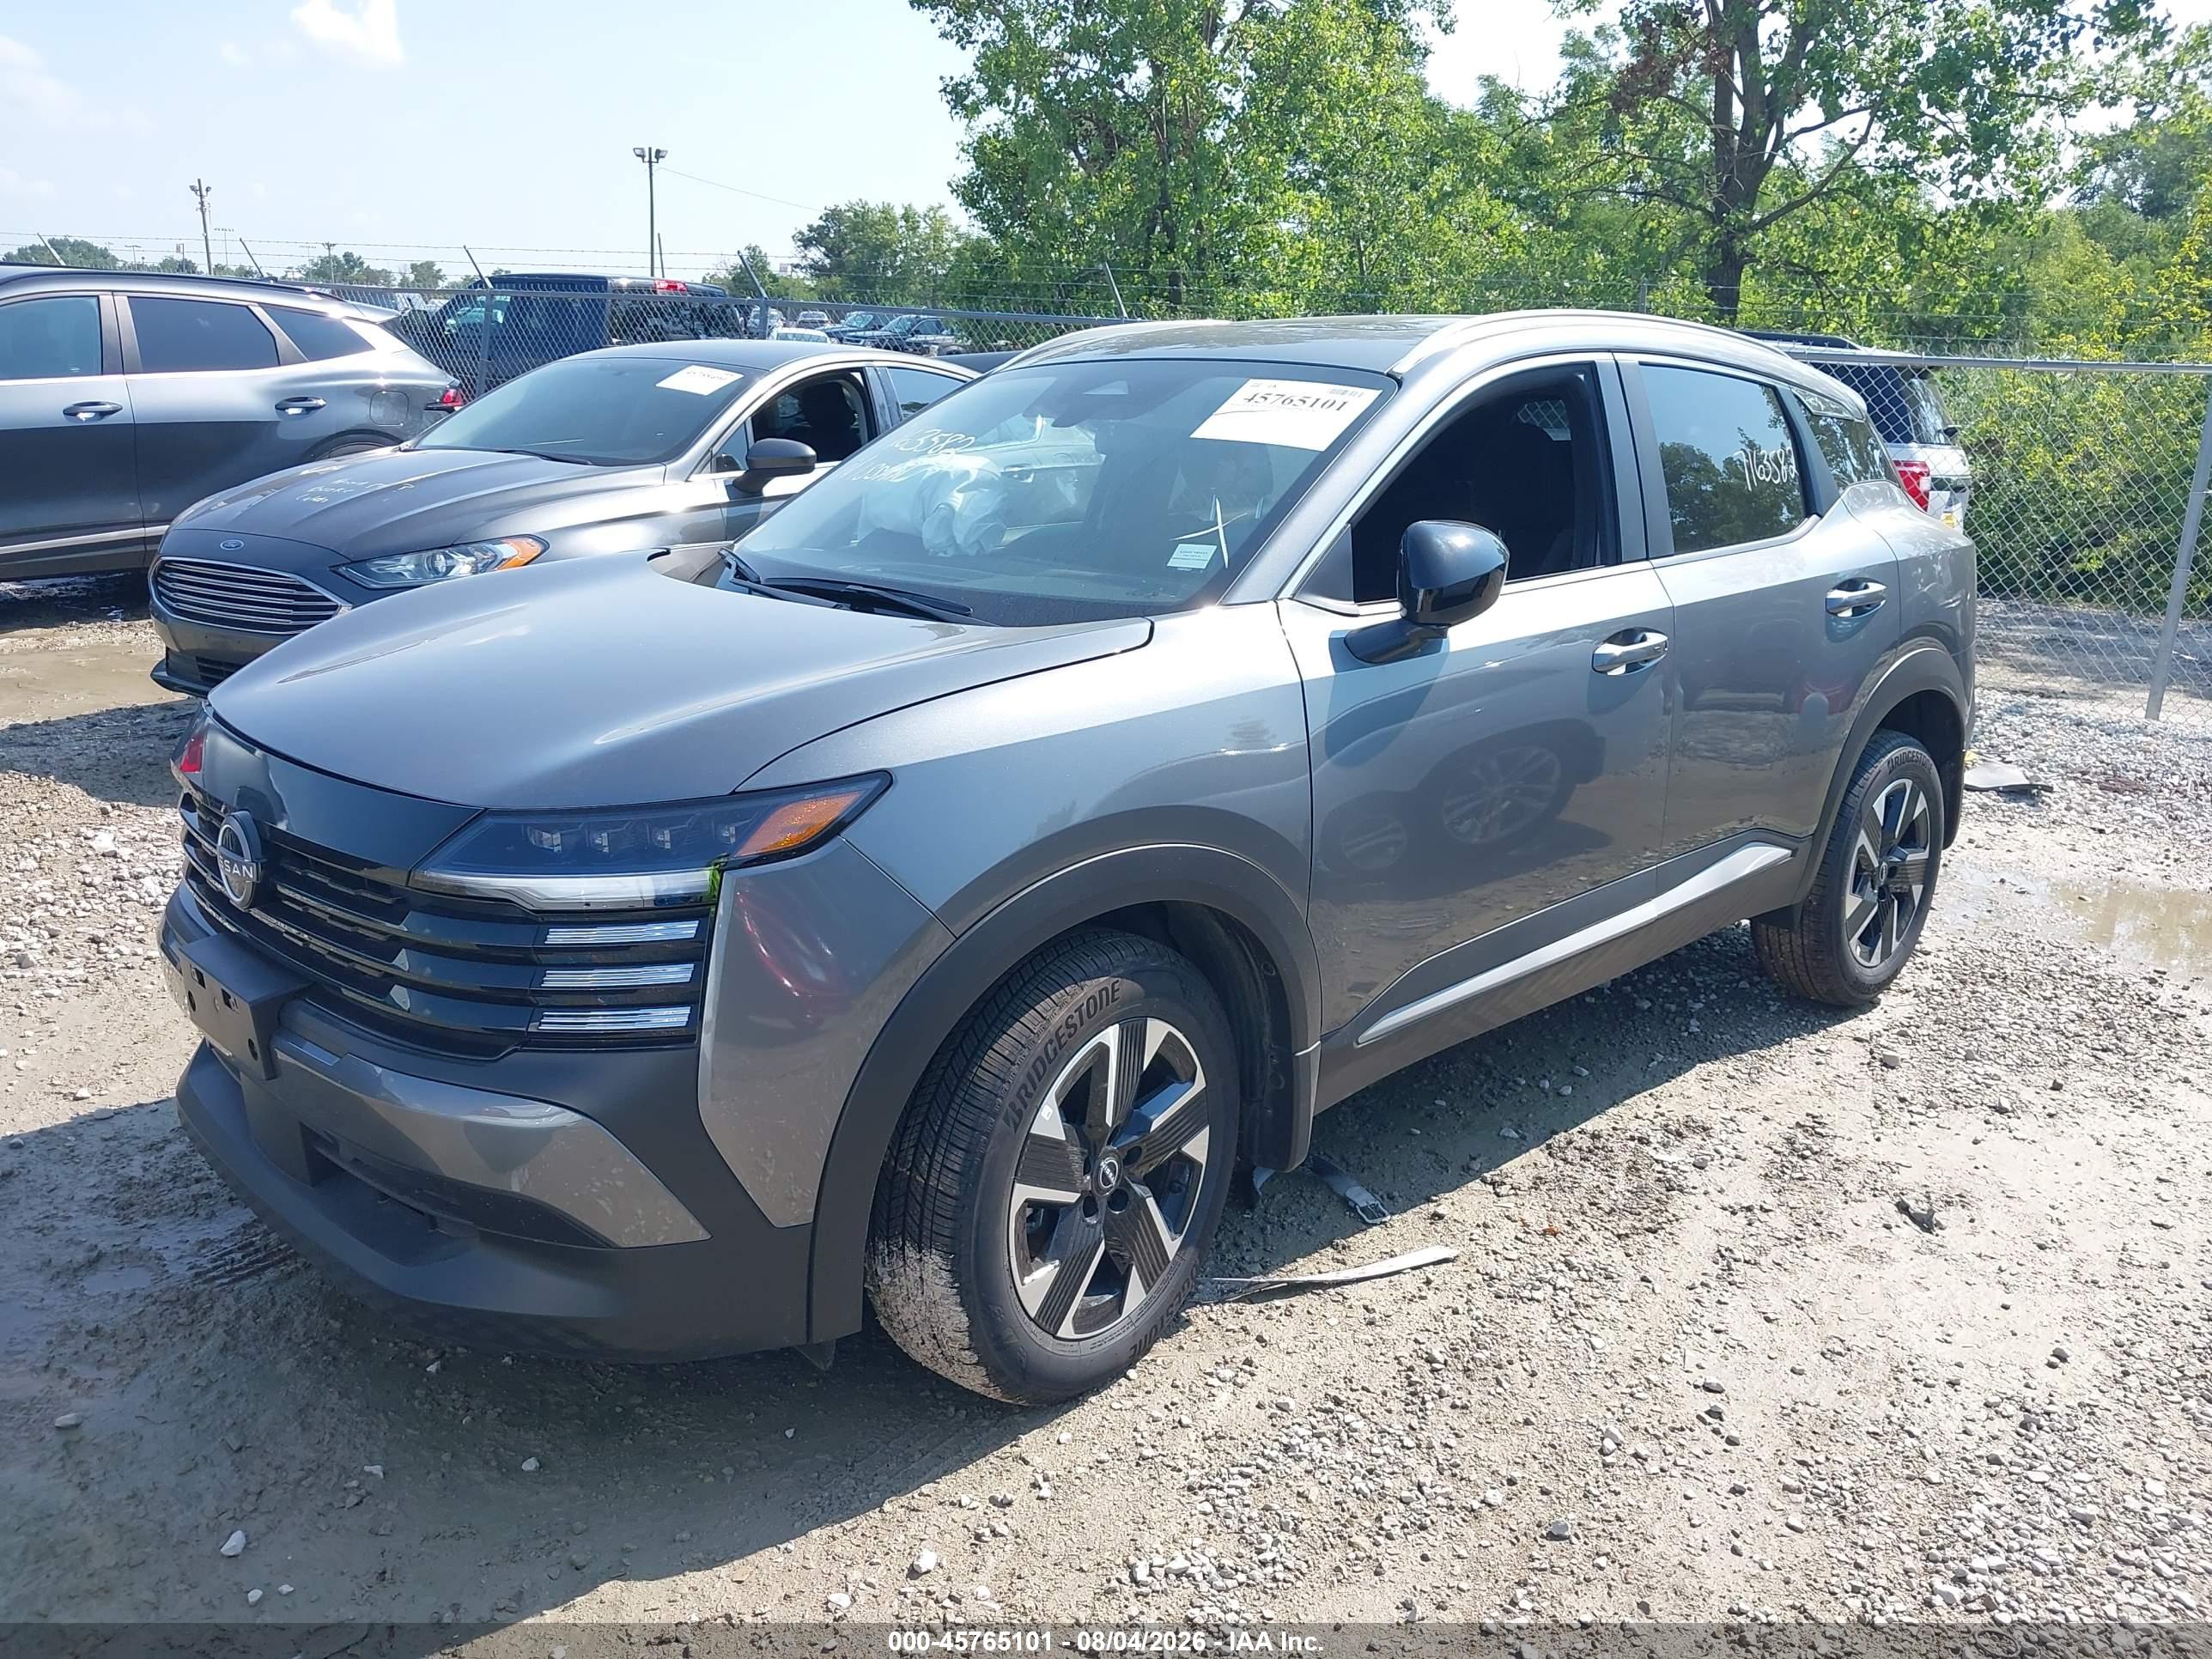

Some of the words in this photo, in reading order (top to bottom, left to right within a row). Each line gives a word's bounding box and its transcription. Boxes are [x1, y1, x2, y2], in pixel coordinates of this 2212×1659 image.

[1243, 392, 1349, 411] 45765101
[1887, 750, 1934, 775] BRIDGESTONE
[1002, 979, 1121, 1134] BRIDGESTONE
